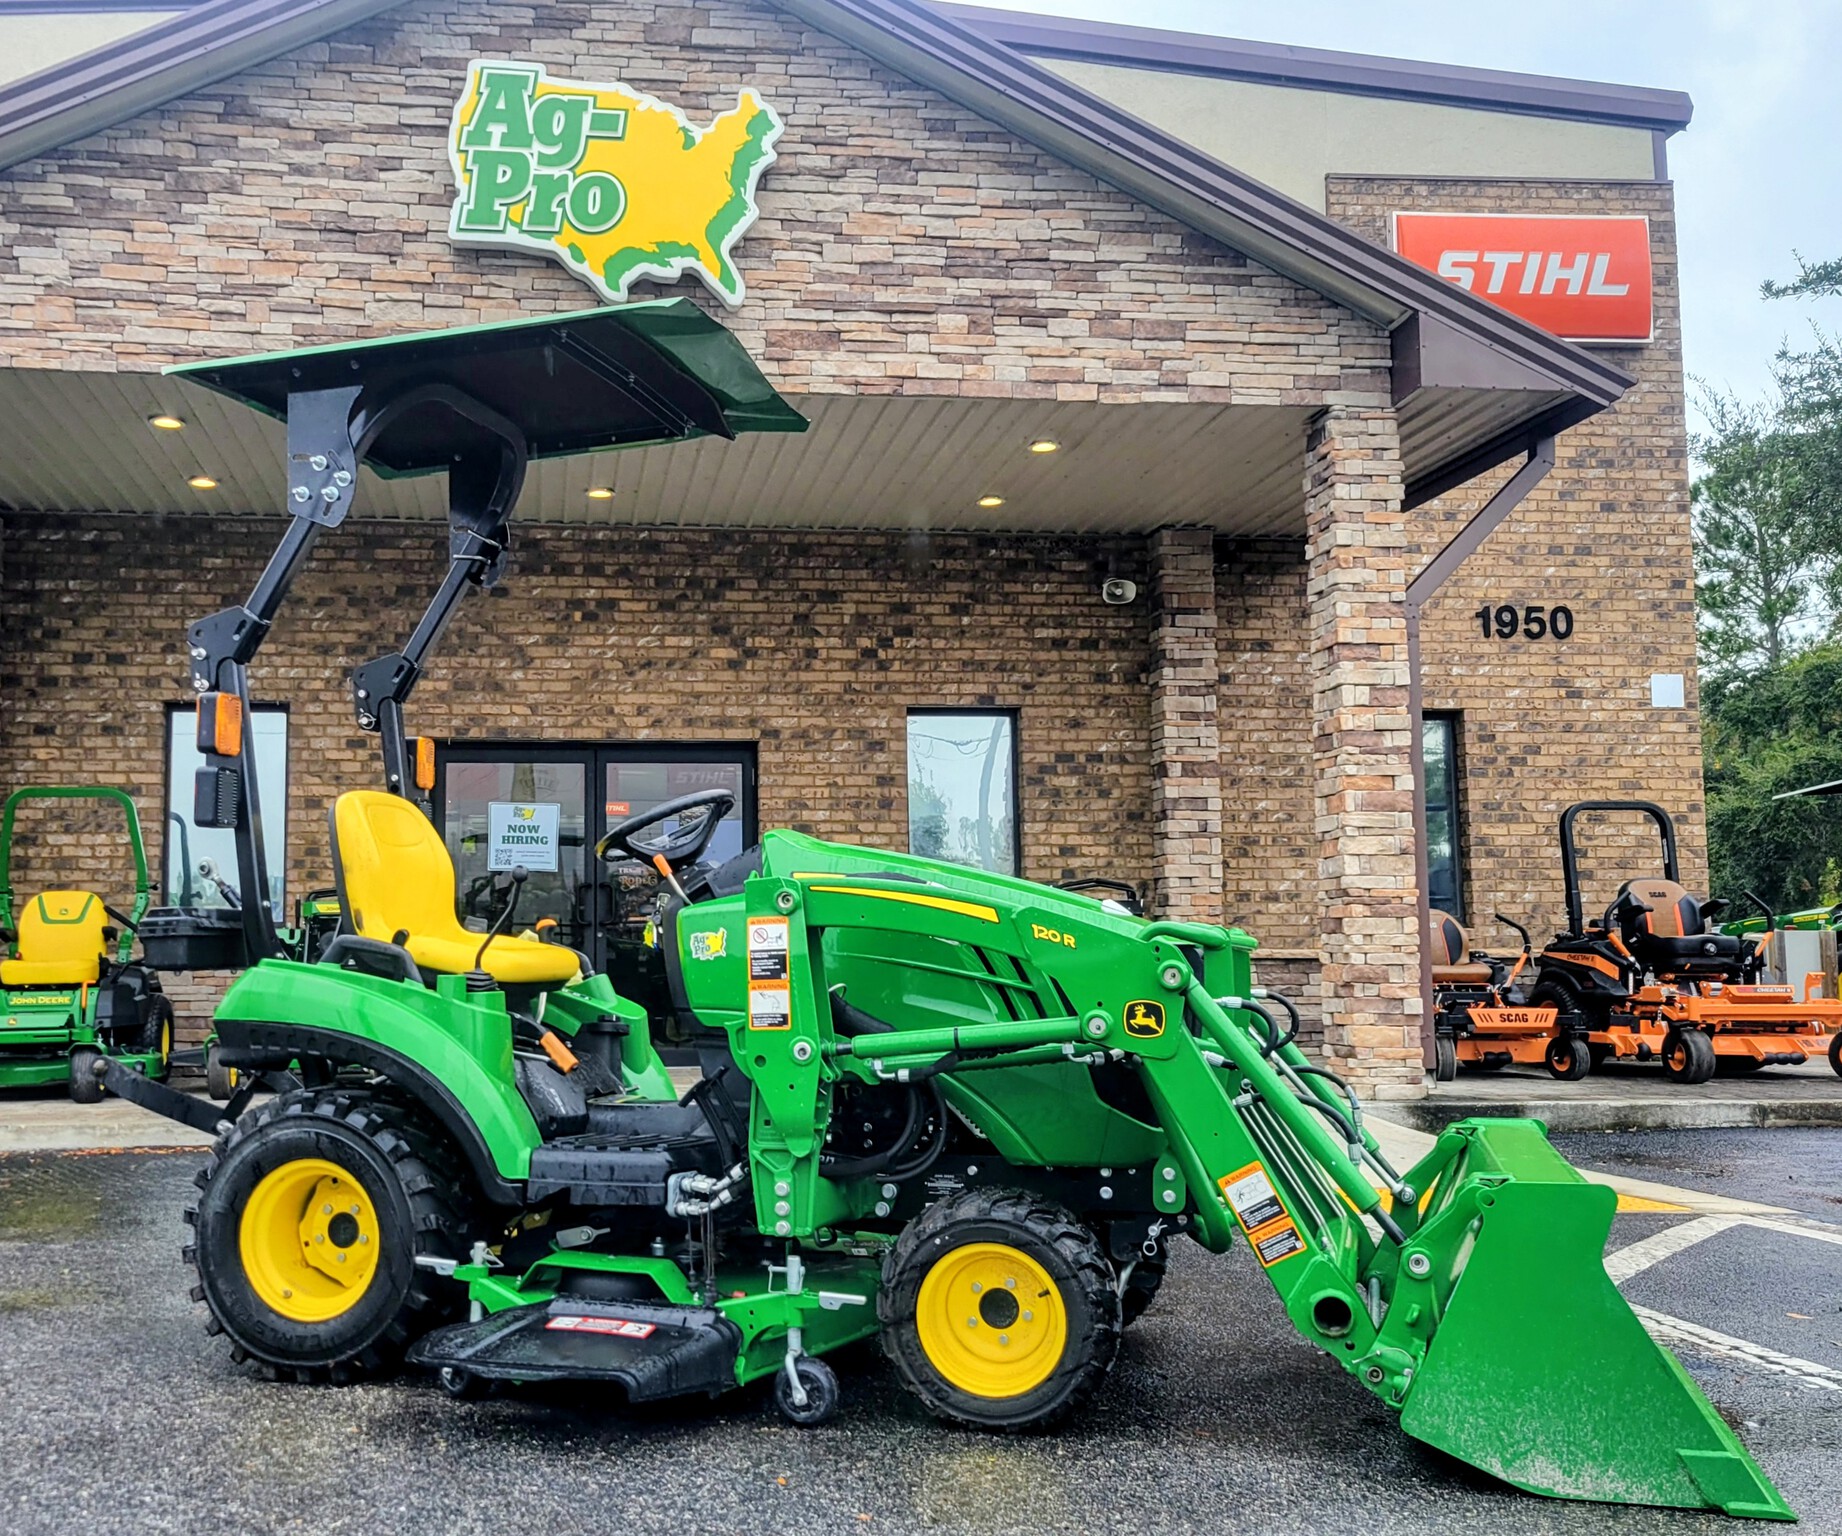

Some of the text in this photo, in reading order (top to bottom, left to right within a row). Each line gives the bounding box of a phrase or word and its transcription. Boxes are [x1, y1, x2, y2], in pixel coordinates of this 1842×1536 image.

[460, 67, 627, 171] Ag-
[458, 150, 626, 233] Pro
[1437, 250, 1630, 296] STIHL
[1475, 605, 1574, 640] 1950
[676, 771, 729, 785] STIHL
[507, 824, 540, 834] NOW
[501, 835, 549, 845] HIRING
[10, 996, 71, 1005] JOHN DEERE
[1499, 1013, 1529, 1023] SCAG
